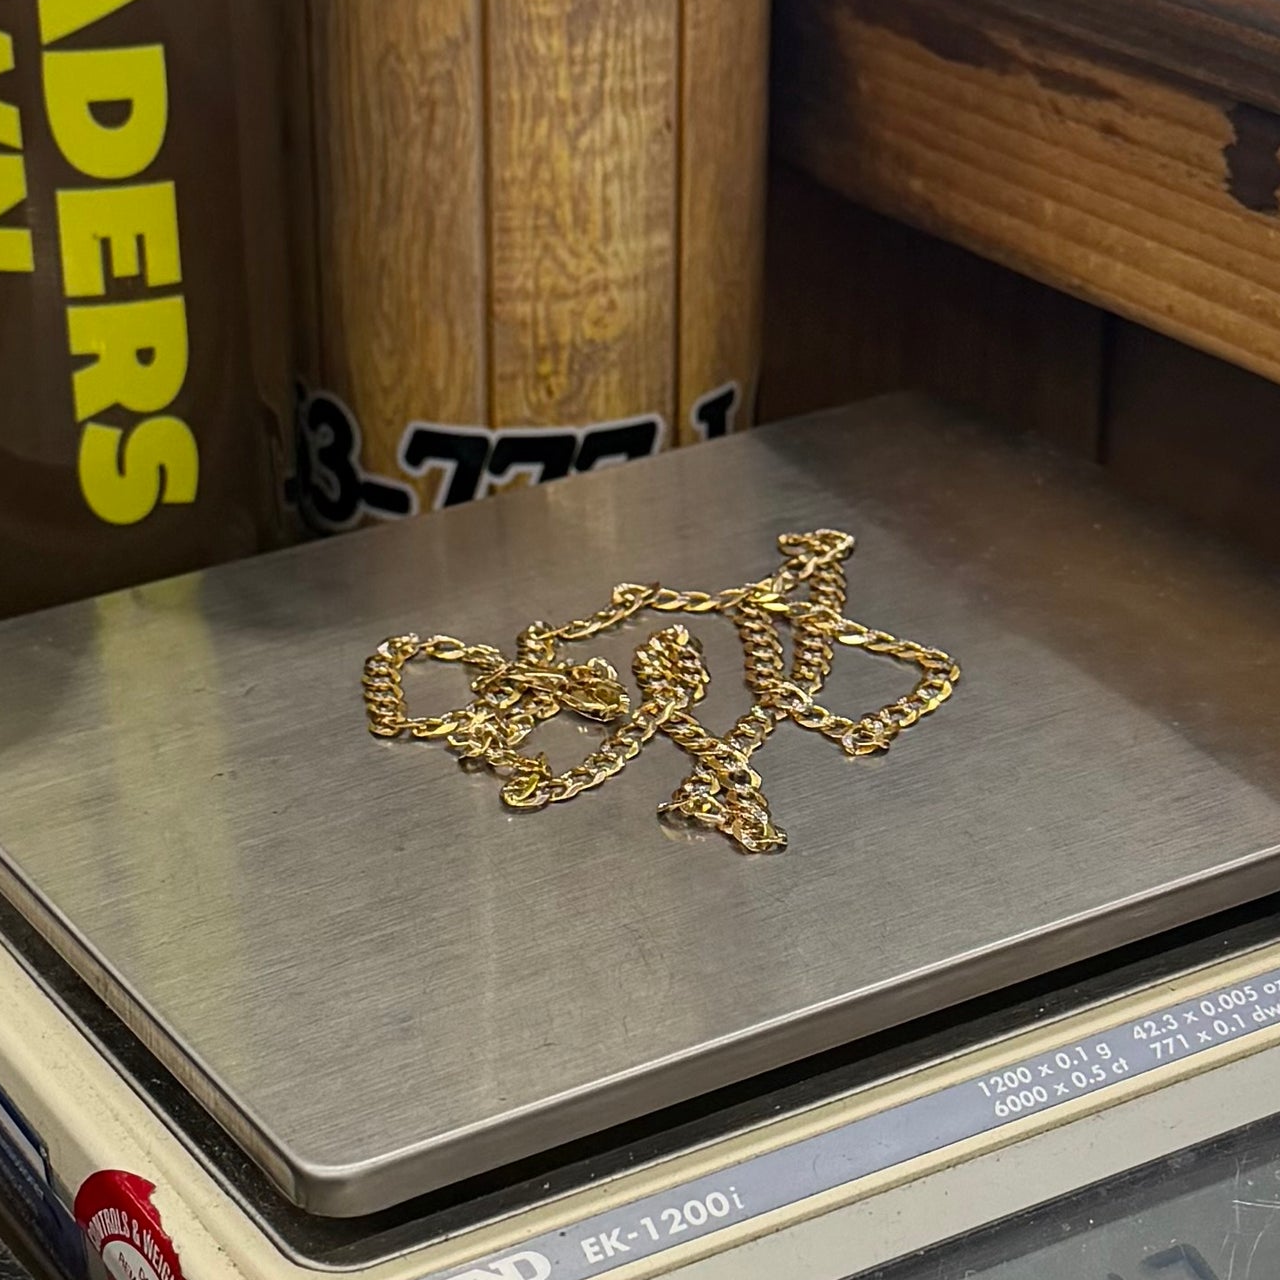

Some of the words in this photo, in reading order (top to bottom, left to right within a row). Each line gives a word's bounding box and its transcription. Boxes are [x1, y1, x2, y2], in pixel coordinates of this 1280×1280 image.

[978, 1066, 1032, 1098] 1200
[1040, 1062, 1054, 1078] x
[1055, 1046, 1089, 1070] 0.1
[1096, 1042, 1112, 1060] g
[1132, 1014, 1179, 1041] 42.3
[1183, 1010, 1199, 1025] x
[1200, 986, 1258, 1016] 0.005
[994, 1086, 1048, 1118] 6000
[1053, 1081, 1069, 1096] x
[1071, 1063, 1107, 1089] 0.5
[1112, 1057, 1129, 1075] ct
[1149, 1034, 1190, 1060] 771
[1197, 1029, 1211, 1044] x
[1213, 1013, 1246, 1036] 0.1
[580, 1186, 745, 1265] EK-1200i
